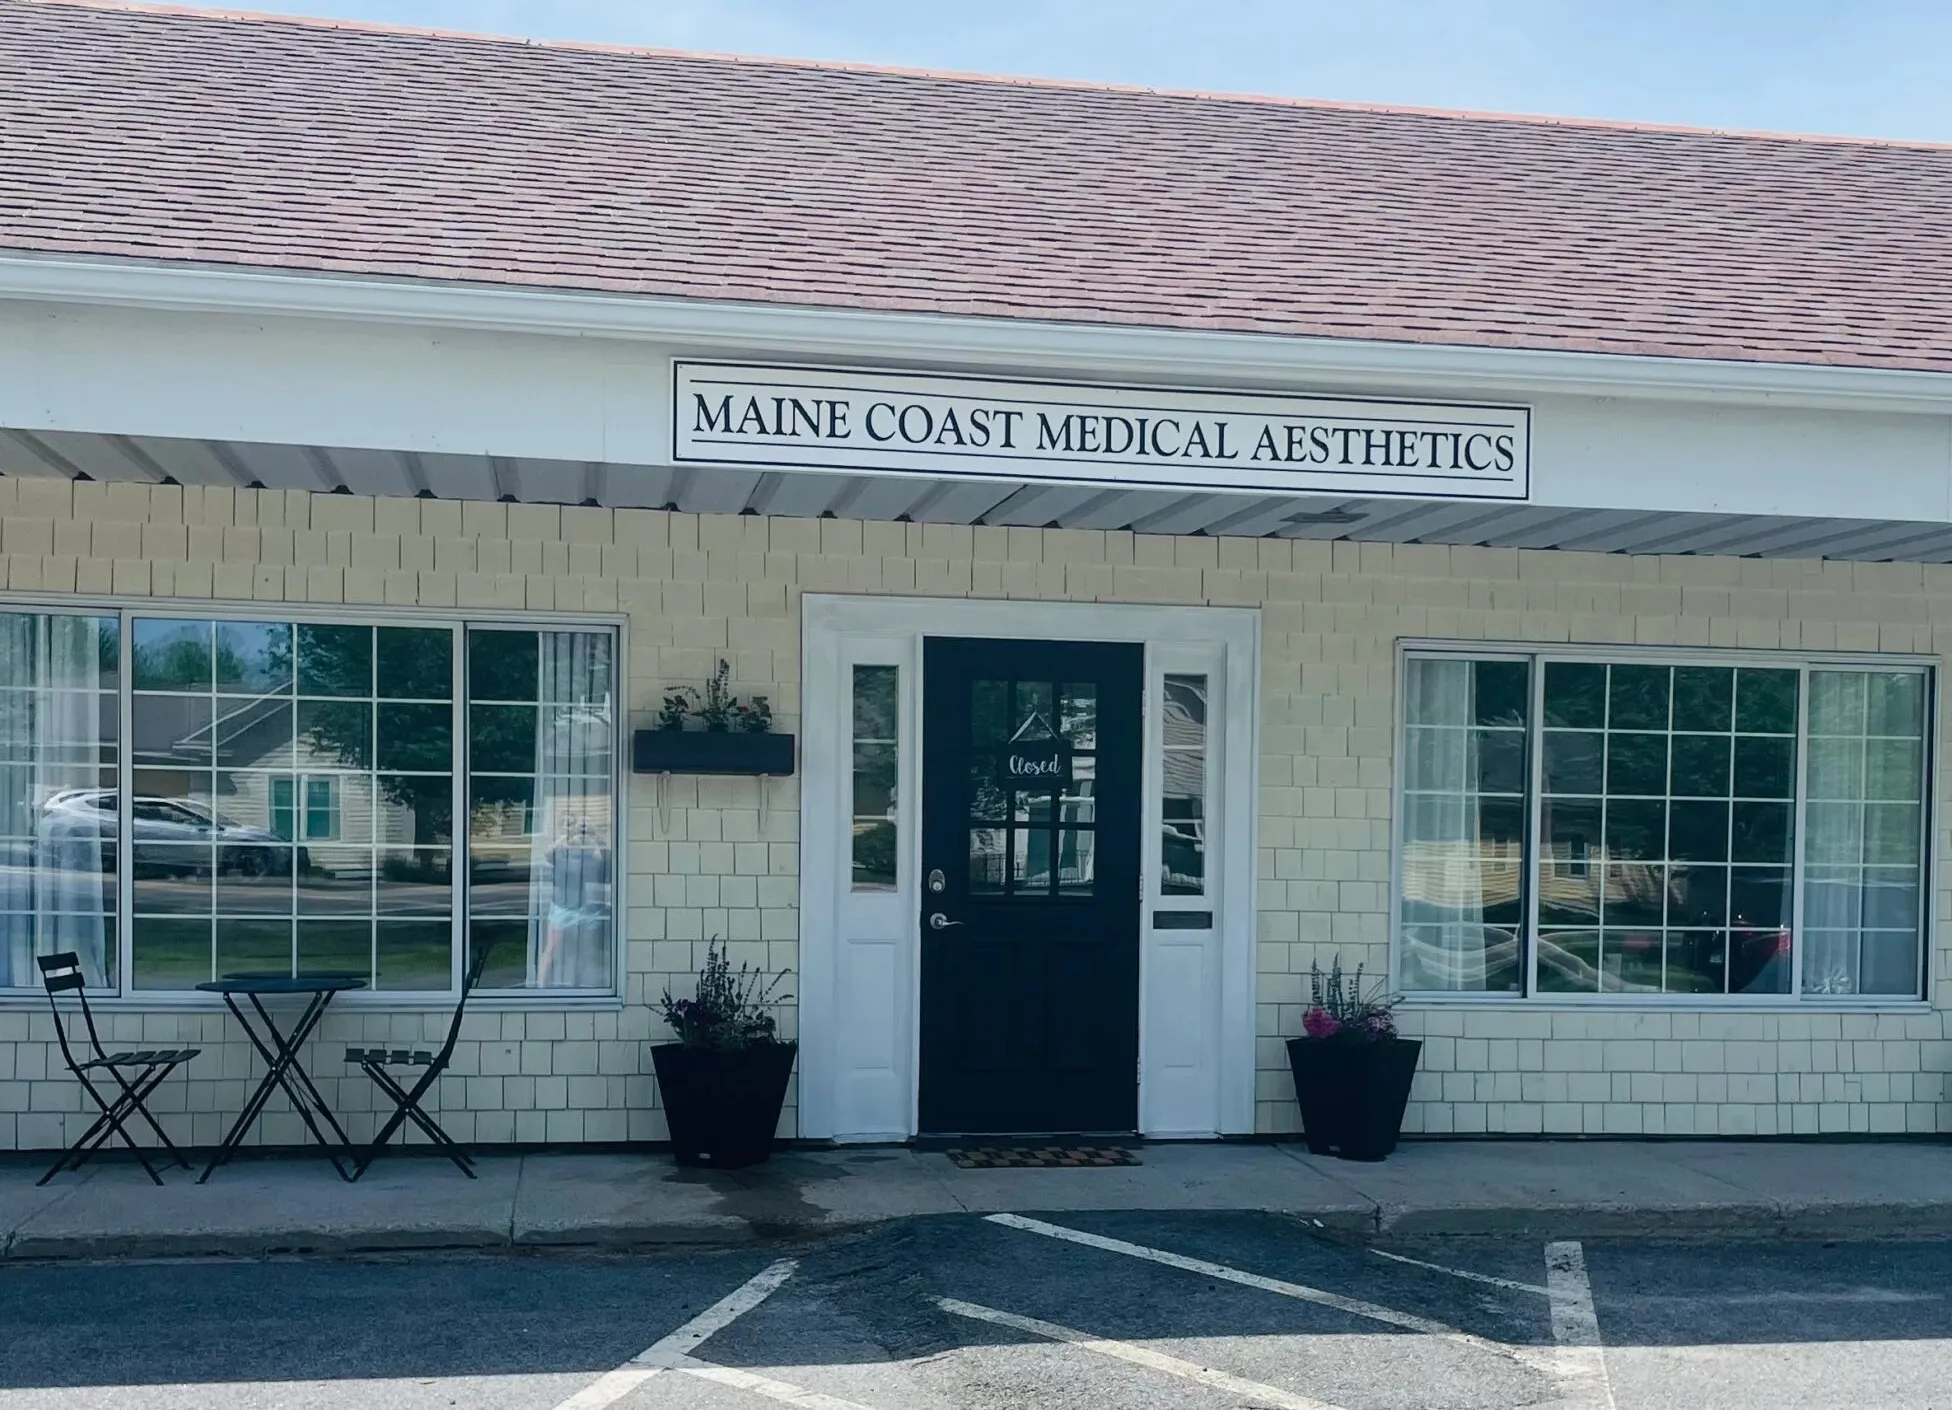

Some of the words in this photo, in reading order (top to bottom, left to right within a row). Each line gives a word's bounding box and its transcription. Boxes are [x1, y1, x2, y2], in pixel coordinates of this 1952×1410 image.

[693, 393, 851, 439] MAINE
[865, 402, 1022, 448] COAST
[1036, 412, 1238, 460] MEDICAL
[1251, 424, 1515, 471] AESTHETICS
[1009, 753, 1061, 775] Closed
